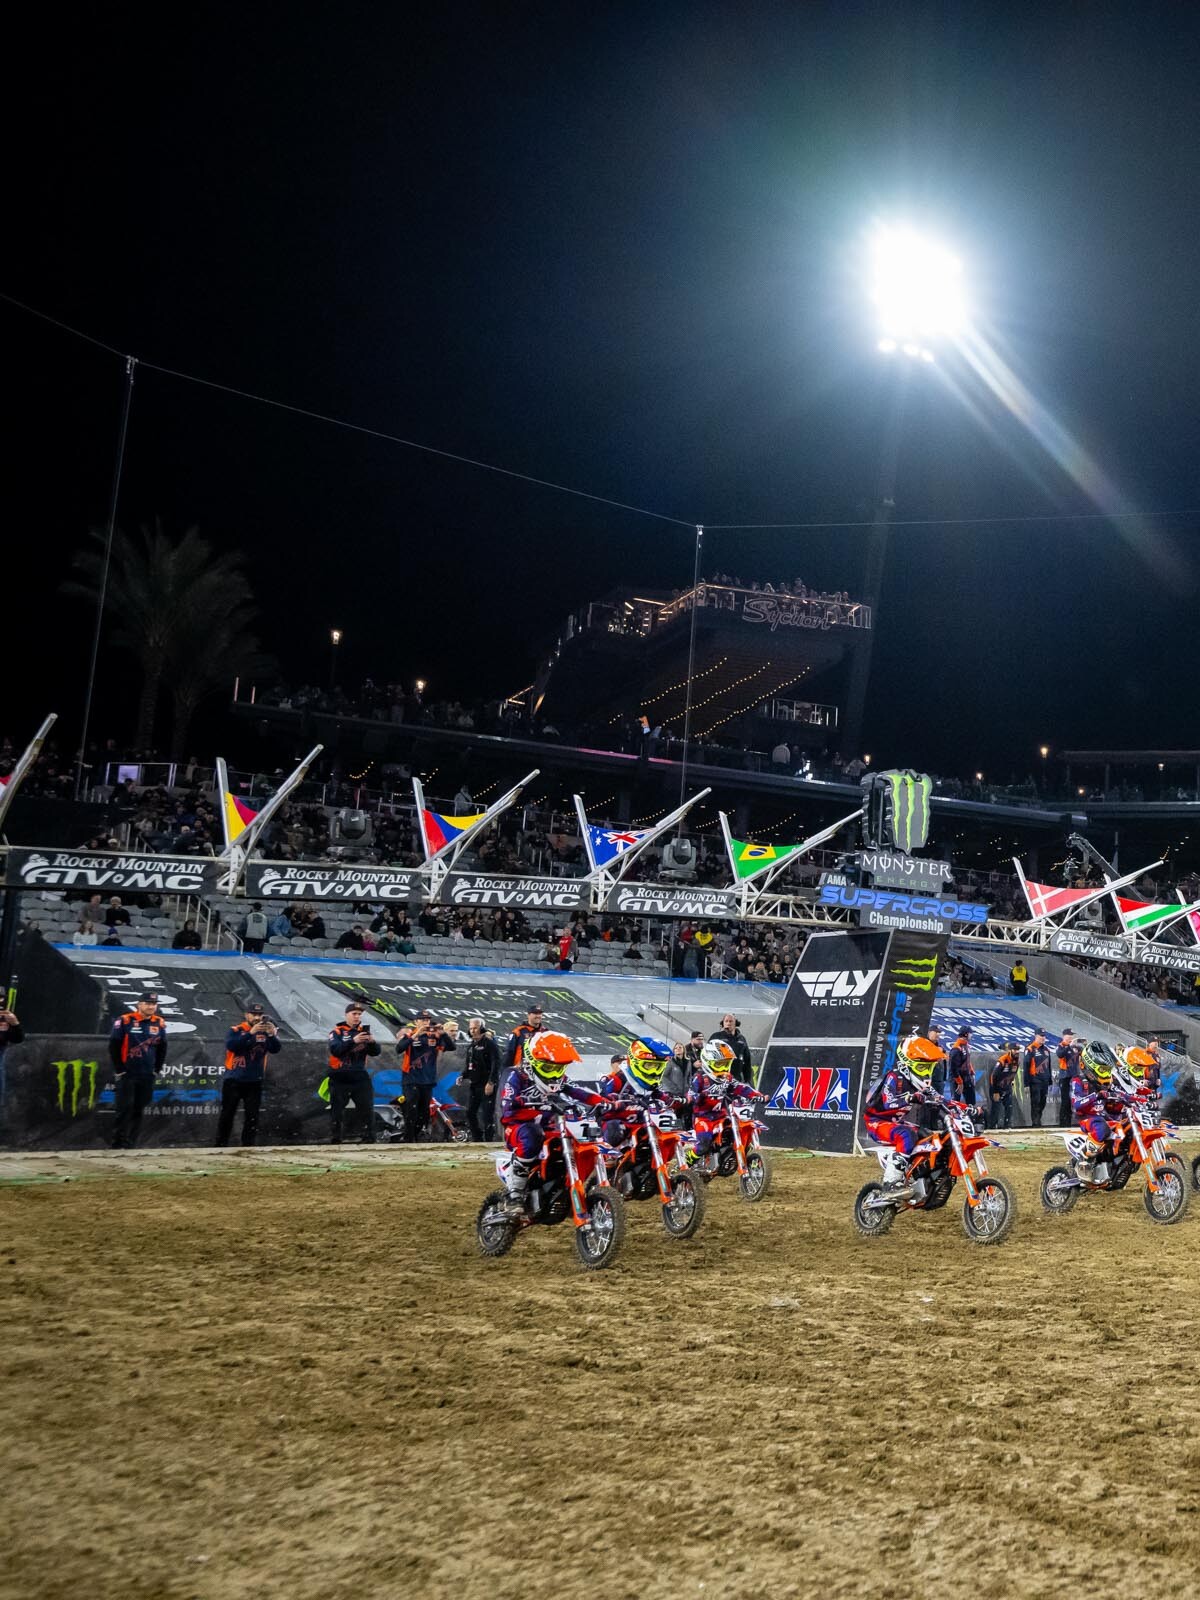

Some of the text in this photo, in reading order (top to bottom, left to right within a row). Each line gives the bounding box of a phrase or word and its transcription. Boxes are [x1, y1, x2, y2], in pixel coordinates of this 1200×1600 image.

[51, 853, 206, 874] ROCKY MOUNTAIN
[863, 853, 953, 882] MONSTER
[284, 867, 411, 884] ROCKY MOUNTAIN
[827, 874, 847, 886] AMA
[875, 875, 938, 888] ENERGY
[473, 877, 581, 893] ROCKY MOUNTAIN
[637, 887, 728, 903] ROCKY MOUNTAIN
[820, 885, 990, 923] SUPERCROSS
[869, 911, 943, 933] Championship
[1068, 933, 1123, 948] ROCKY MOUNTAIN
[1152, 946, 1200, 960] ROCKY MOUNTAIN
[379, 984, 537, 998] MONSTER
[796, 969, 881, 997] FLY
[869, 1020, 887, 1086] CHAMPIONS
[764, 1066, 854, 1113] AMA
[739, 1108, 753, 1119] 4
[788, 1111, 820, 1119] MOTORCYCLIST
[821, 1112, 852, 1120] ASSOCIATION
[960, 1121, 973, 1134] 3
[1069, 1136, 1085, 1149] 5
